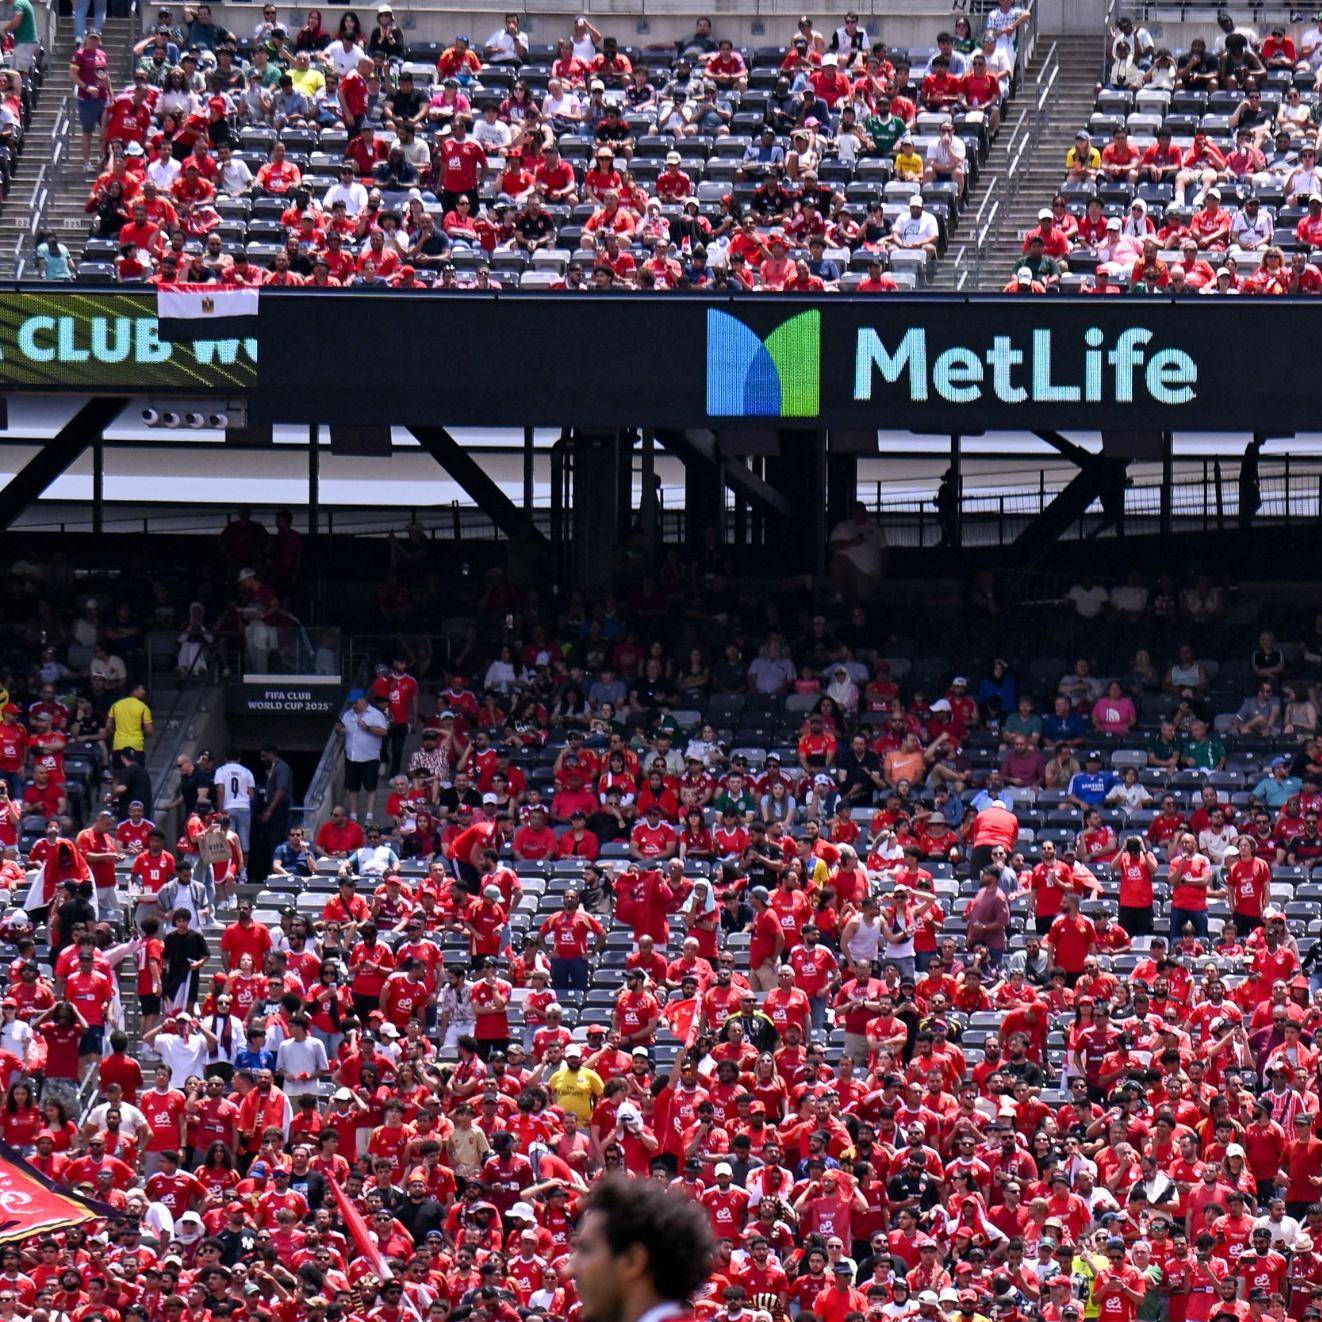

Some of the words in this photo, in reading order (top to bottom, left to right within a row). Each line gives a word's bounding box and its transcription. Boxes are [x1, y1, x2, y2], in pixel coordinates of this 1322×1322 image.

[18, 314, 173, 365] CLUB
[853, 326, 1199, 405] MetLife
[264, 691, 286, 701] FIFA
[286, 691, 312, 701] CLUB
[247, 701, 281, 711] WORLD
[283, 701, 304, 711] CUP
[231, 778, 239, 798] 9
[150, 869, 159, 880] 10
